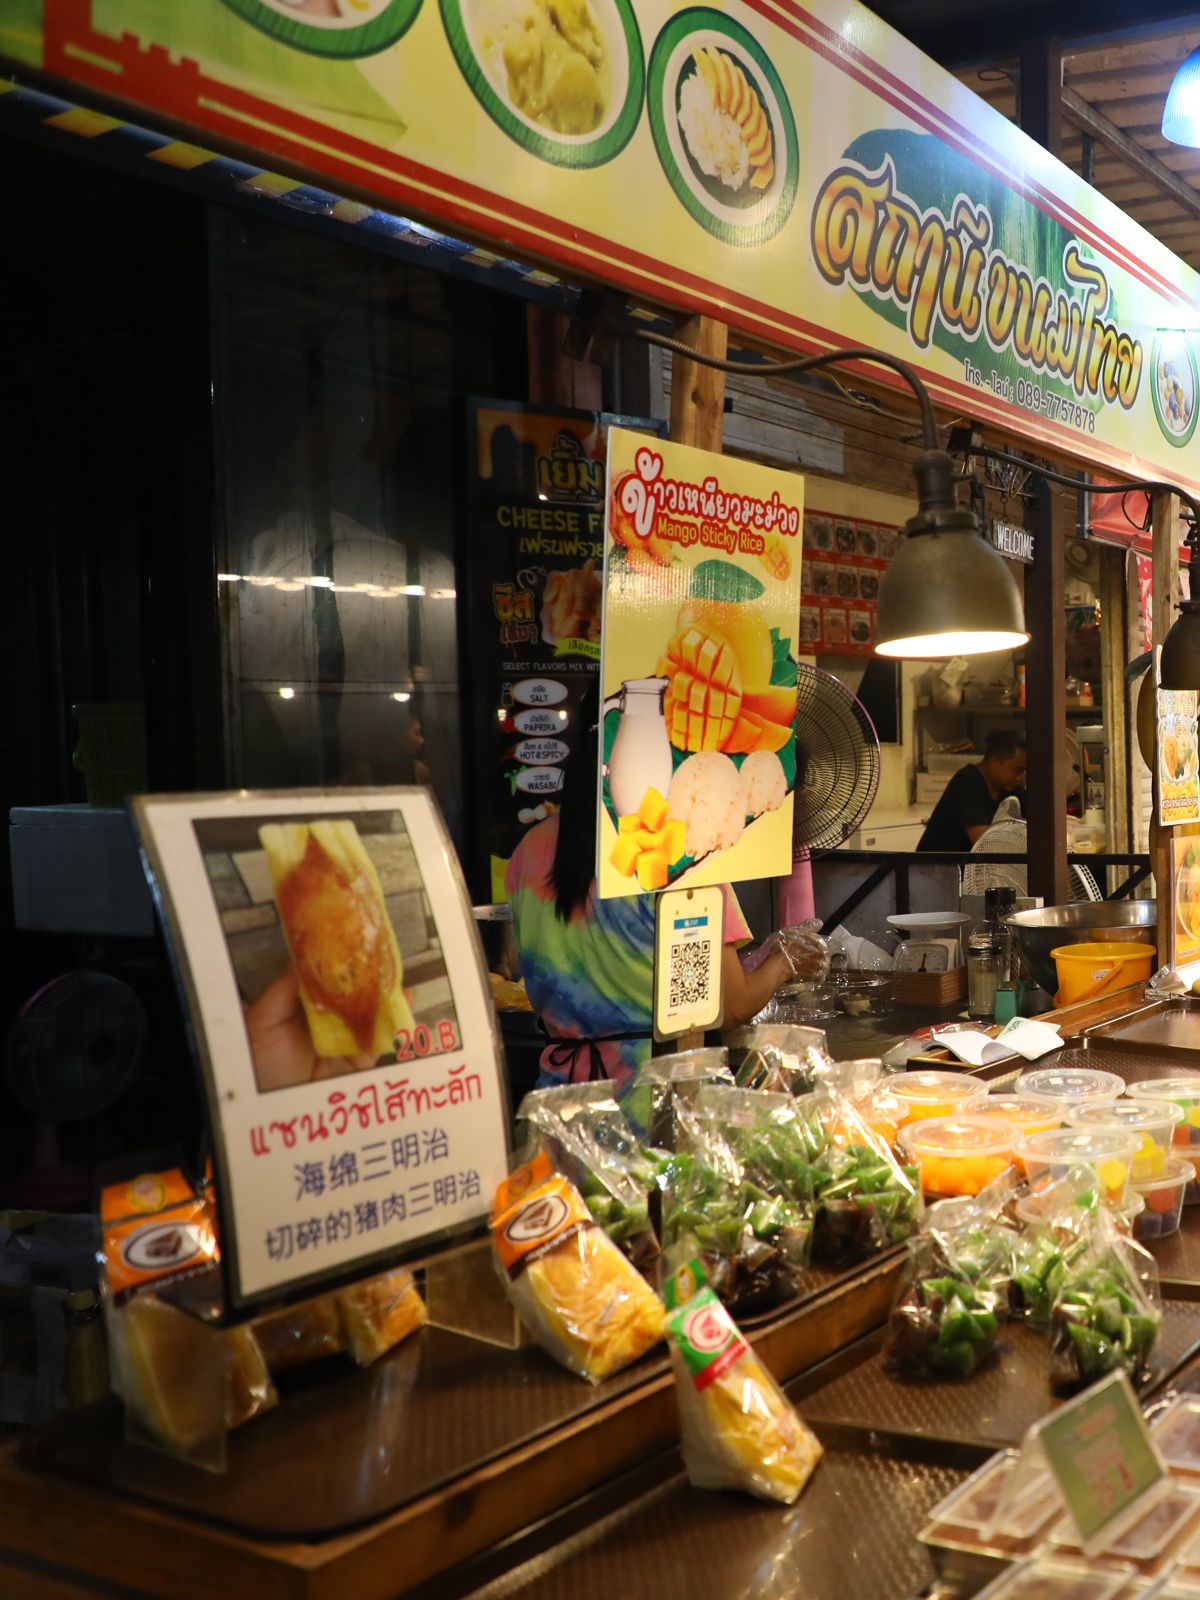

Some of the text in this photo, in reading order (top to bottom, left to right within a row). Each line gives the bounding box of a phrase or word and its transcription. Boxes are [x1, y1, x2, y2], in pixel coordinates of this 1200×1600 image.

[1018, 379, 1096, 433] 089-7757878
[620, 450, 799, 537] ข้าวเหนียวมะม่วง
[497, 506, 580, 533] CHEESE
[658, 517, 763, 551] Mango Sticky Rice
[997, 524, 1035, 561] WELCOME
[502, 662, 530, 671] SELECT
[533, 662, 567, 671] FLAVORS
[569, 662, 583, 671] MIX
[530, 694, 549, 703] SALT
[524, 723, 557, 732] PAPRIKA
[527, 782, 557, 791] WASABI
[293, 1127, 450, 1201] 海绵三明治
[264, 1168, 481, 1262] 切碎的猪肉三明治
